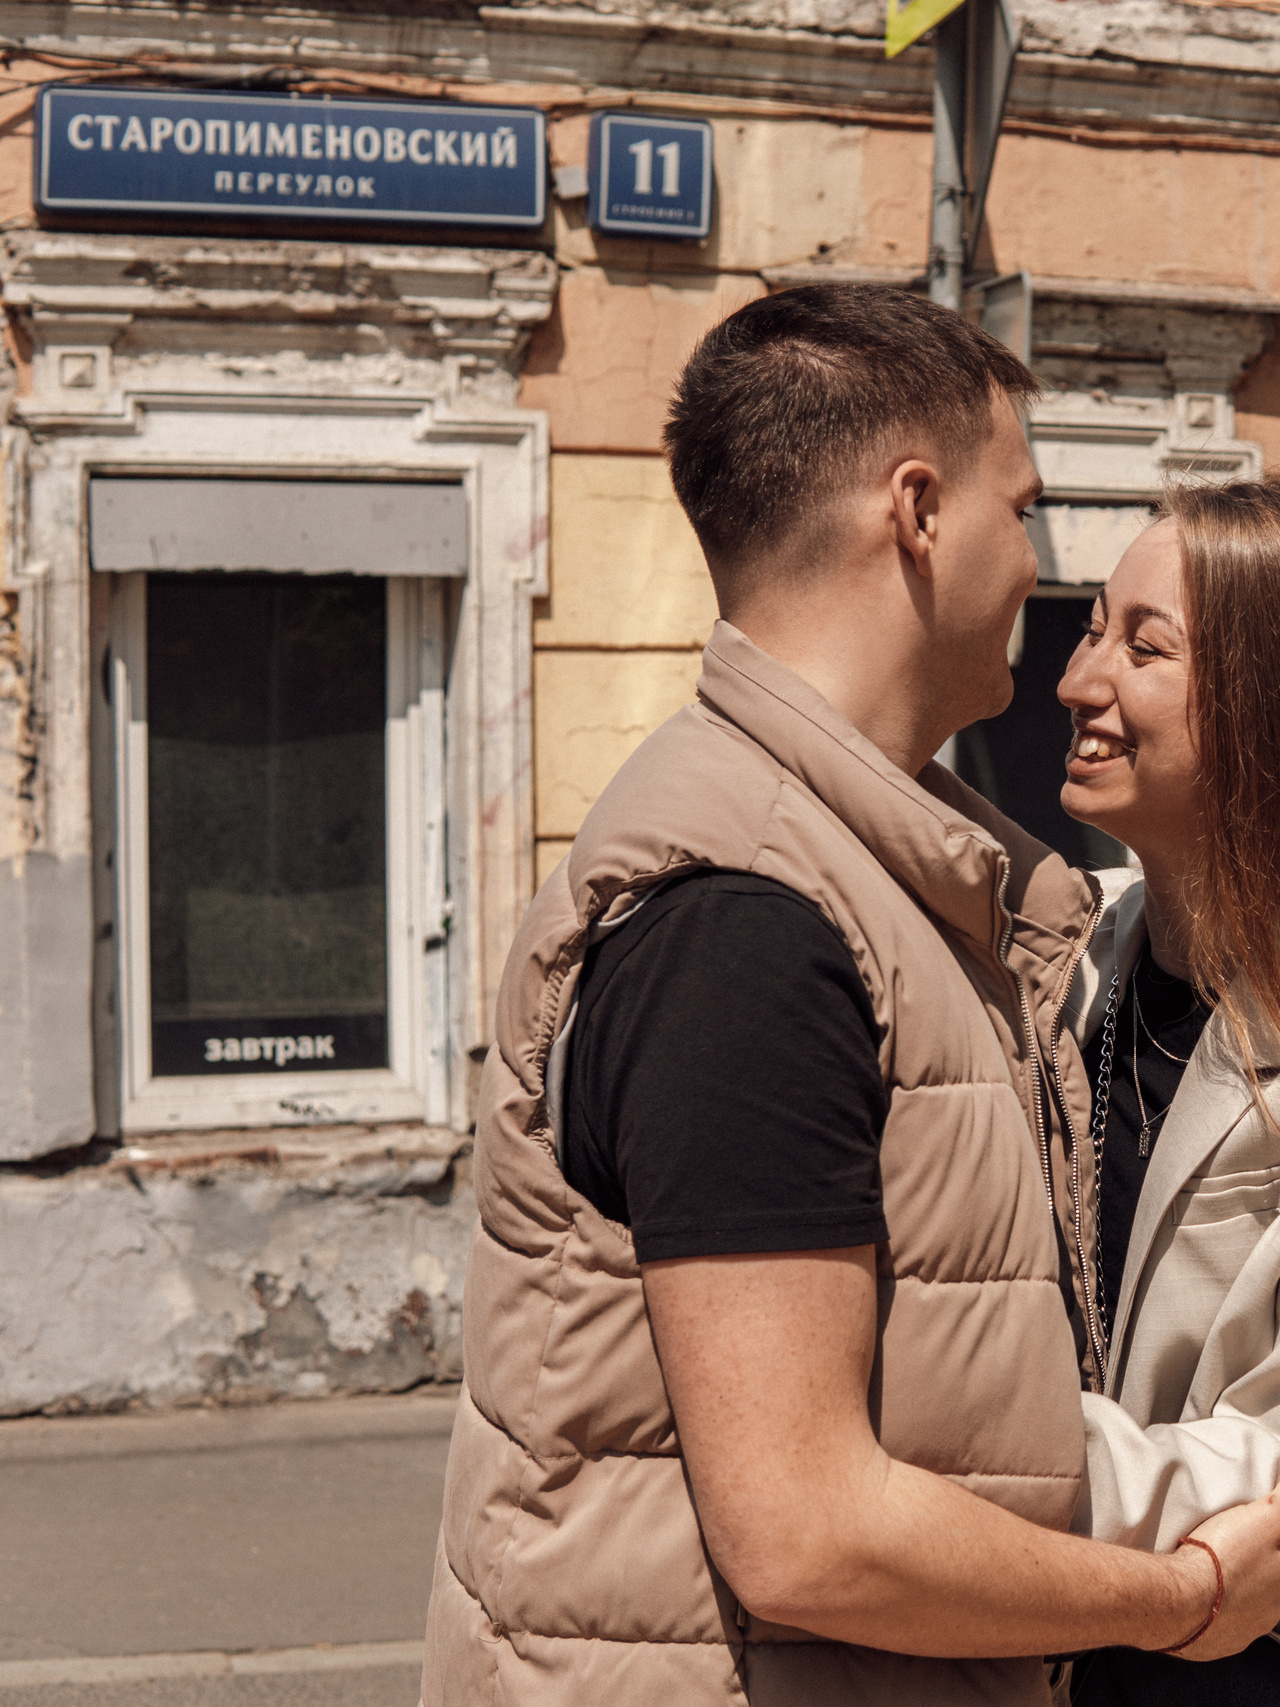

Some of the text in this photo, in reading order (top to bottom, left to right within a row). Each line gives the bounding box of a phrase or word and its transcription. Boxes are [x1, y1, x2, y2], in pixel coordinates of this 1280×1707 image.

[67, 113, 519, 169] СТАРОПИМЕНОВСКИЙ
[214, 170, 376, 198] ПЕРЕУЛОК
[628, 139, 681, 197] 11
[204, 1035, 336, 1066] завтрак
